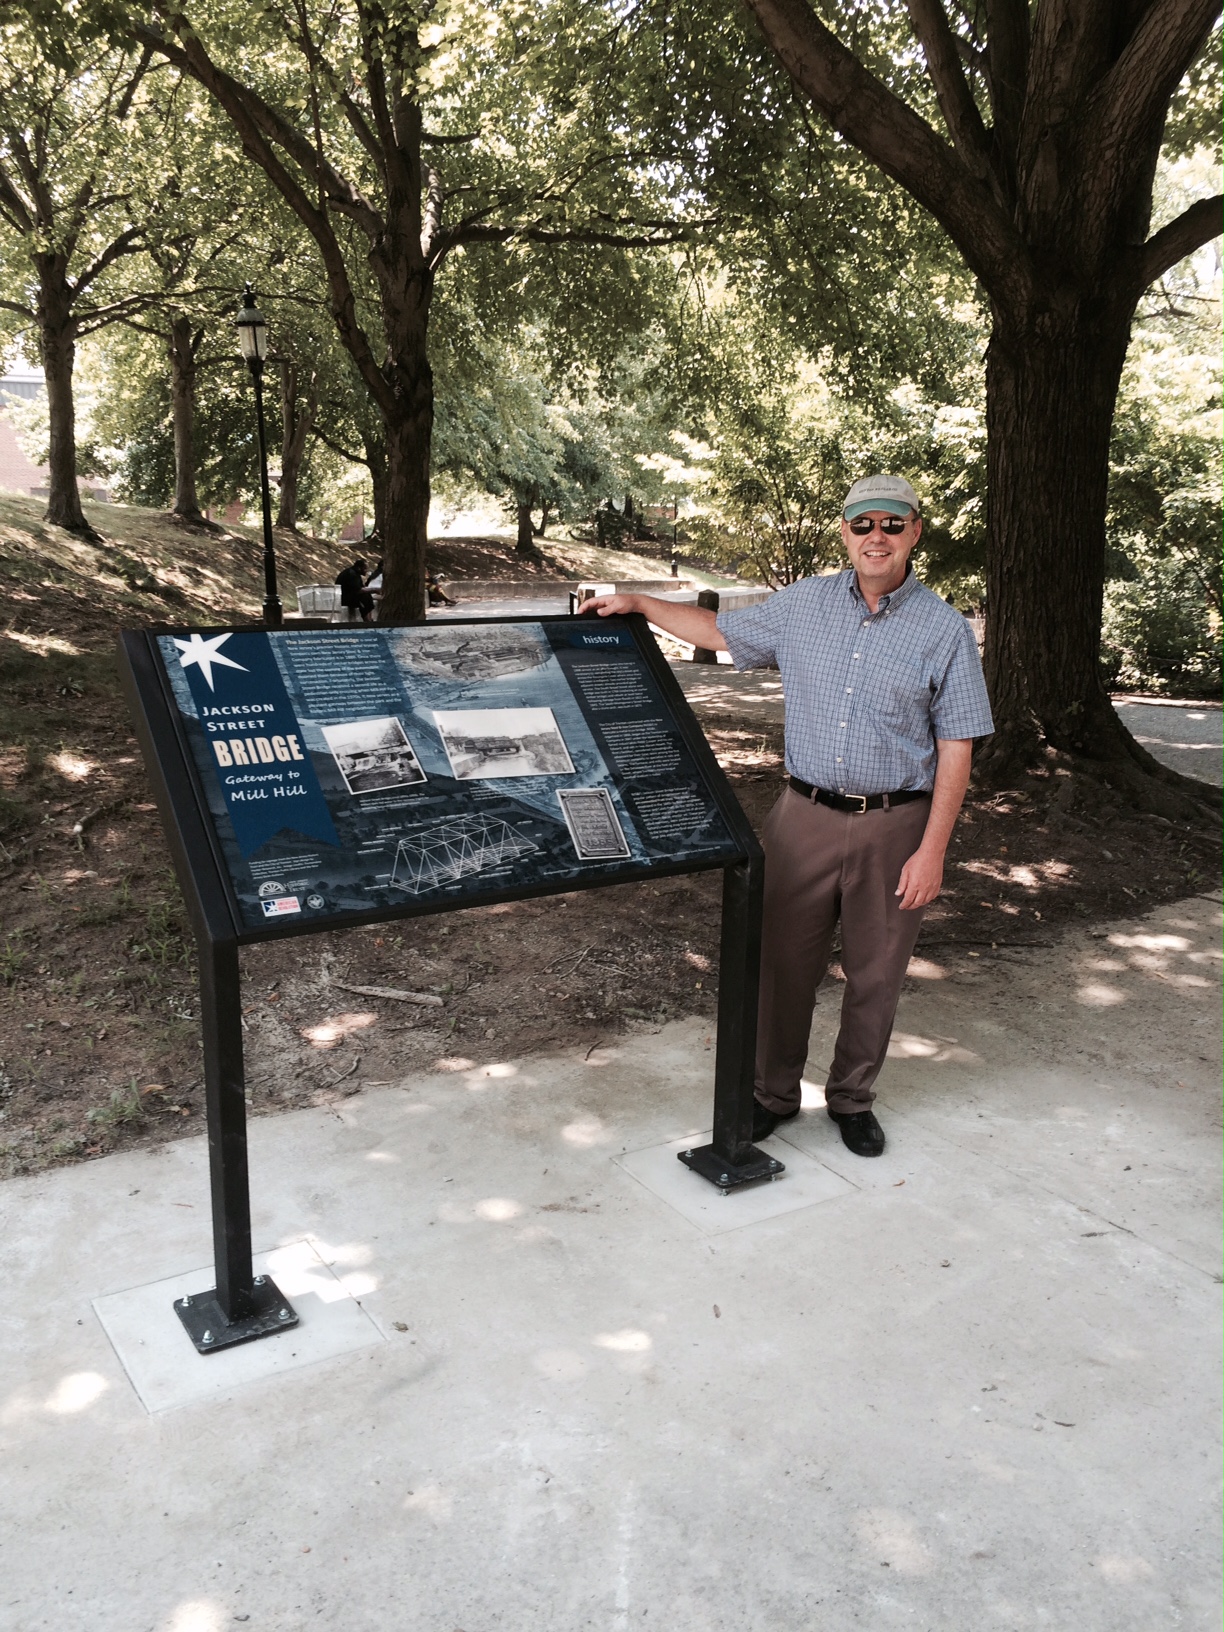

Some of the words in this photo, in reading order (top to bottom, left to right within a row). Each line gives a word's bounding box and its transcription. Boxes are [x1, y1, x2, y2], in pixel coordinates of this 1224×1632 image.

[582, 635, 619, 644] history
[202, 703, 275, 716] JACKSON
[206, 719, 265, 732] STREET
[212, 734, 305, 767] BRIDGE
[225, 773, 283, 785] Gateway
[287, 770, 300, 779] to
[231, 789, 269, 802] Mill
[273, 785, 307, 798] Hill
